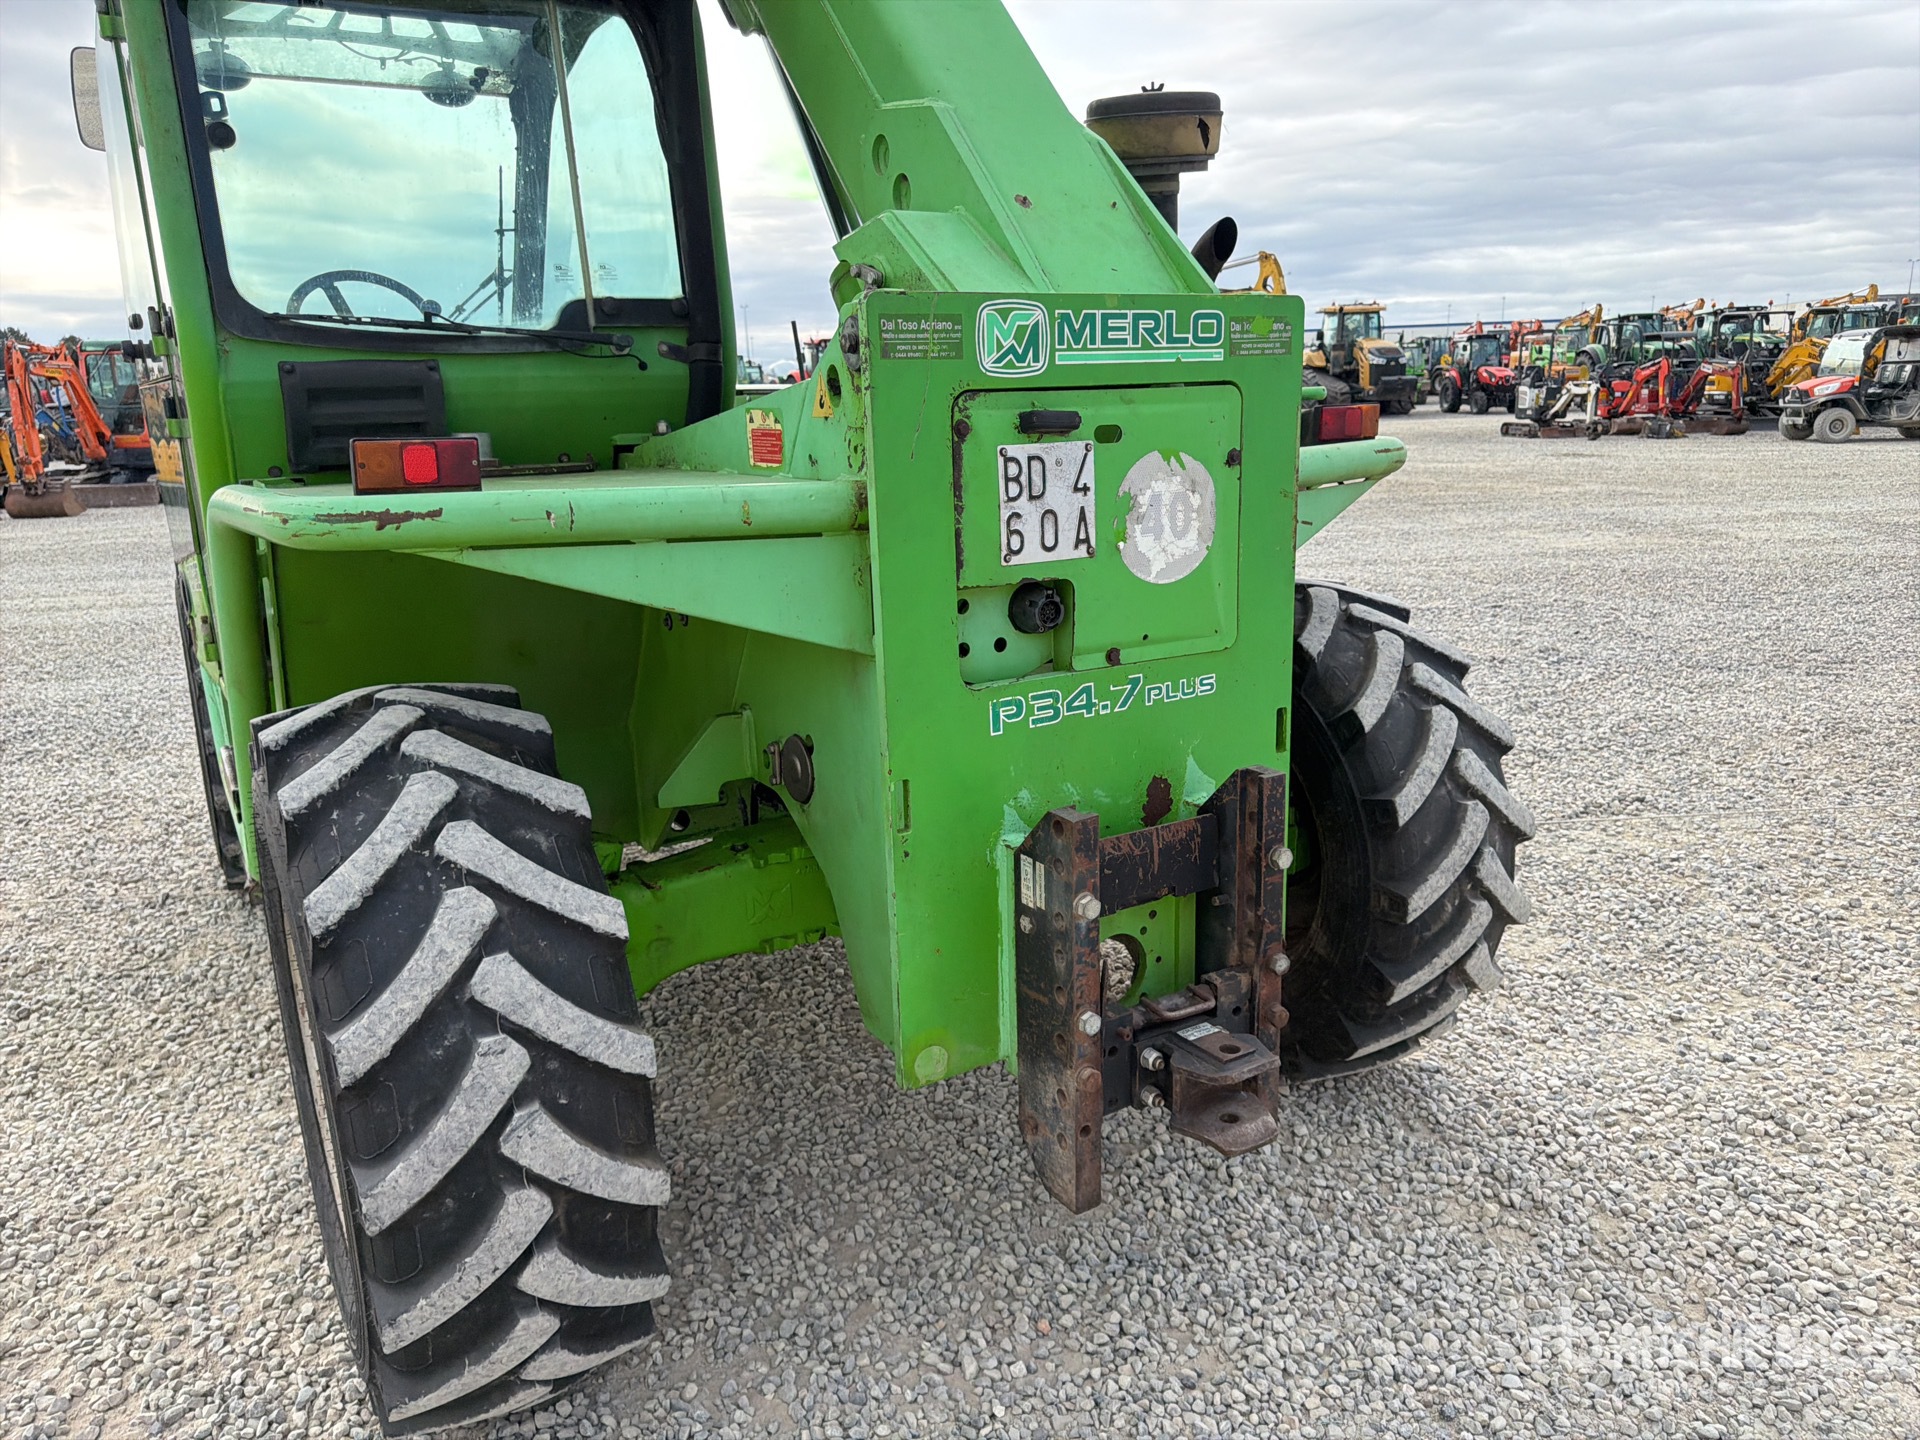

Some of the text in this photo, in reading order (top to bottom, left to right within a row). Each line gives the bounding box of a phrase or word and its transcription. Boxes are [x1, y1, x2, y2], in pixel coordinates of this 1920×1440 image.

[880, 319, 895, 330] Dal
[897, 319, 918, 330] Toso
[1055, 309, 1224, 348] MERLO
[1002, 452, 1091, 503] BD 4
[1138, 491, 1194, 542] 40
[988, 673, 1217, 736] P34.7 PLUS
